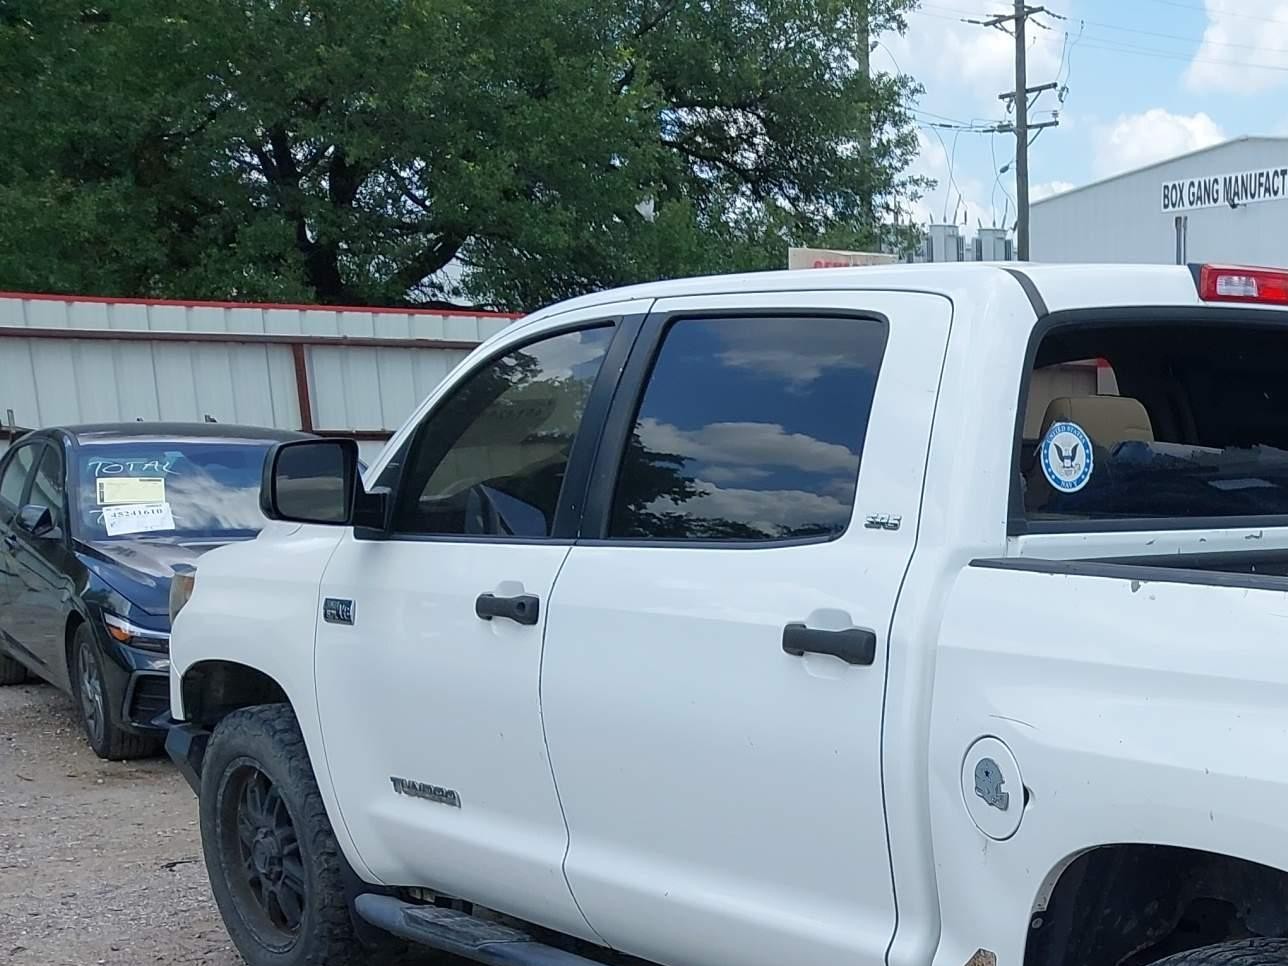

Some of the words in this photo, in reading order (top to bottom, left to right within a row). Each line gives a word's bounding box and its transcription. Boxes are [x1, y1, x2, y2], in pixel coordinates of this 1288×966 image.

[1163, 183, 1185, 210] BOX
[1187, 177, 1219, 206] GANG
[1046, 426, 1067, 444] UNITED
[1067, 425, 1086, 444] STATES
[88, 459, 184, 477] TOTAL
[1060, 480, 1078, 489] NAVY
